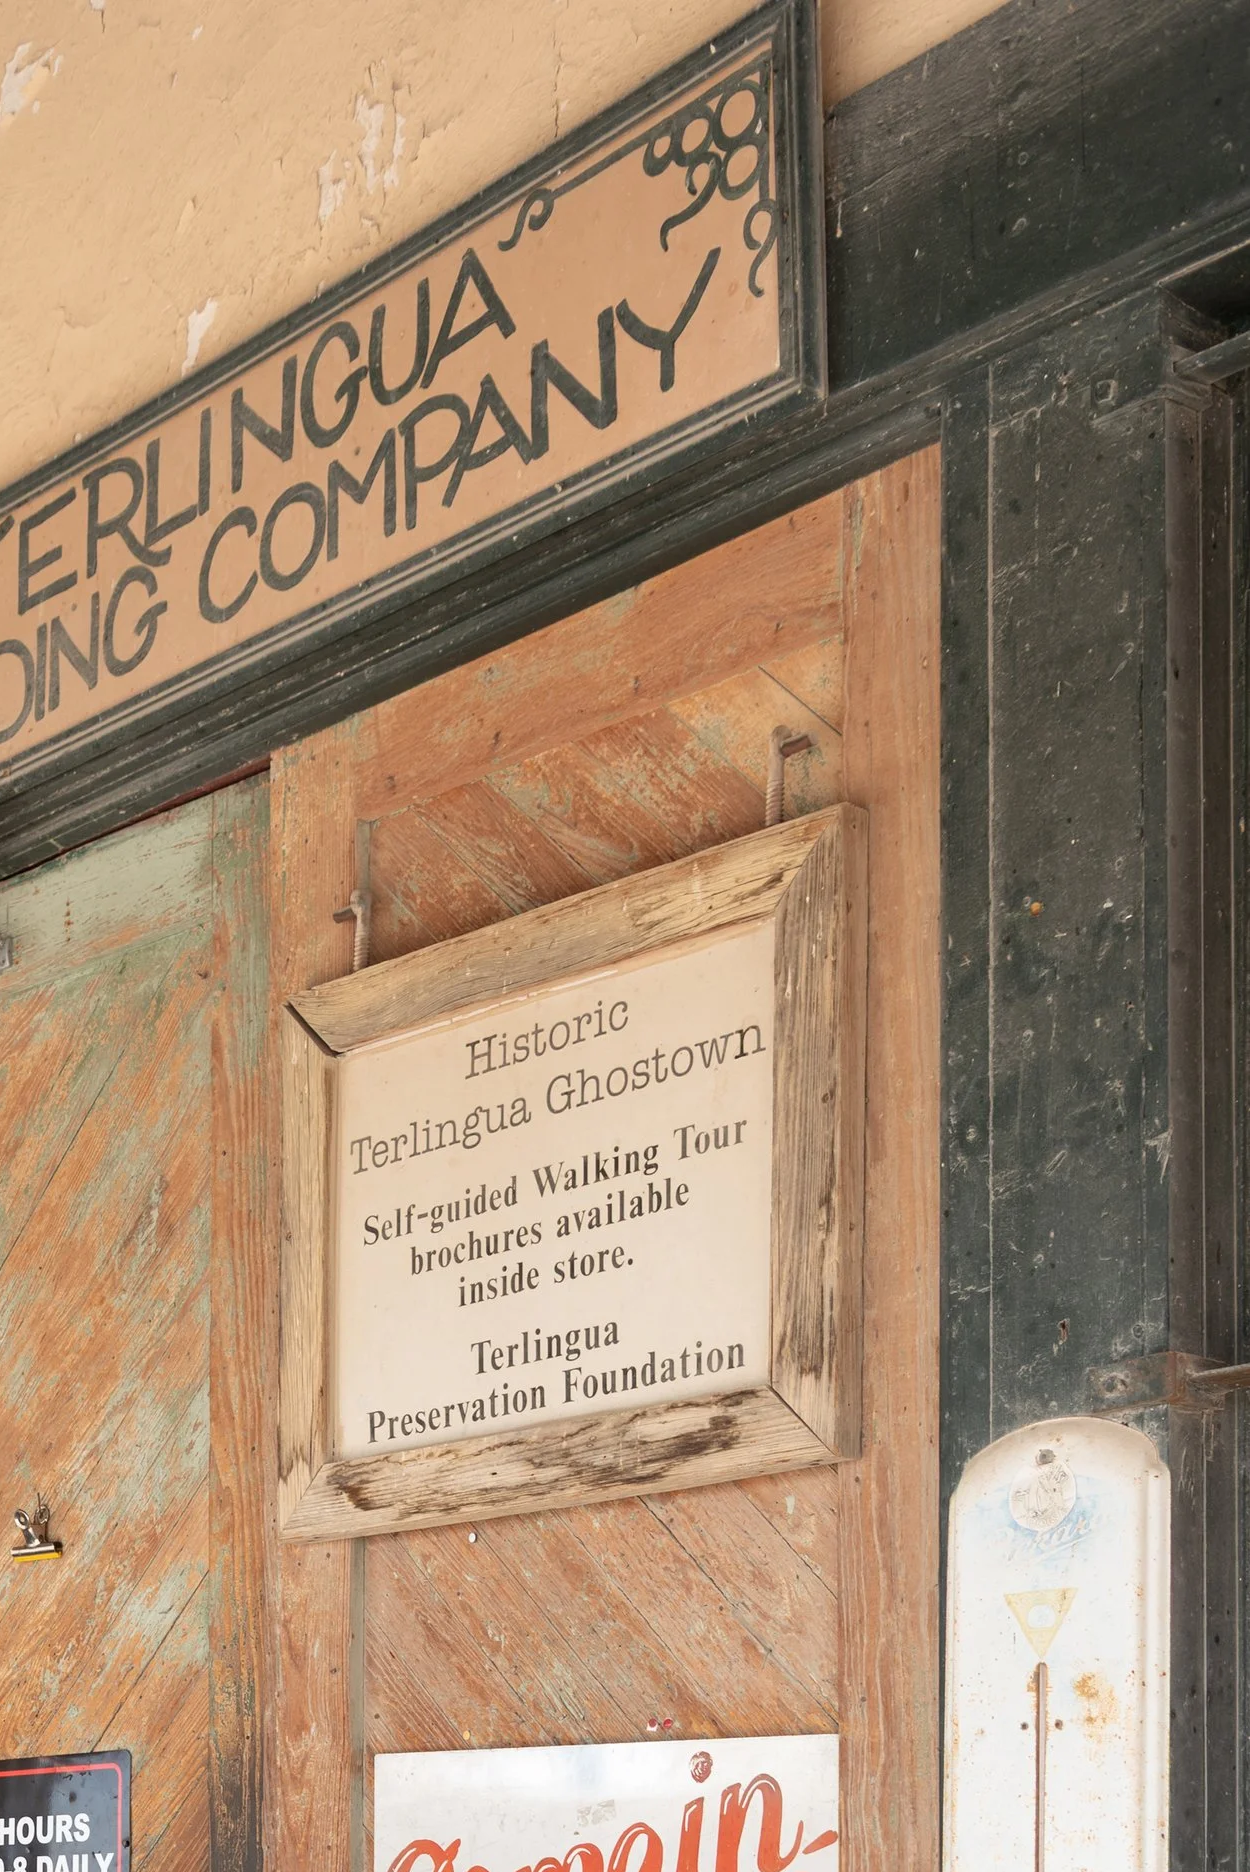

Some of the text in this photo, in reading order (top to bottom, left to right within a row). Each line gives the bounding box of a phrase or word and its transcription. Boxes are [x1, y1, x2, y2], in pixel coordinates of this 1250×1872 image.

[198, 247, 721, 625] COMPANY
[464, 999, 630, 1080] Historic
[351, 1022, 766, 1175] Terlingua Ghostown
[363, 1117, 749, 1247] Self-guided Walking Tour
[410, 1180, 690, 1276] brochures available
[458, 1245, 634, 1307] inside store.
[367, 1339, 746, 1444] Preservation Foundation
[470, 1321, 619, 1376] Terlingua
